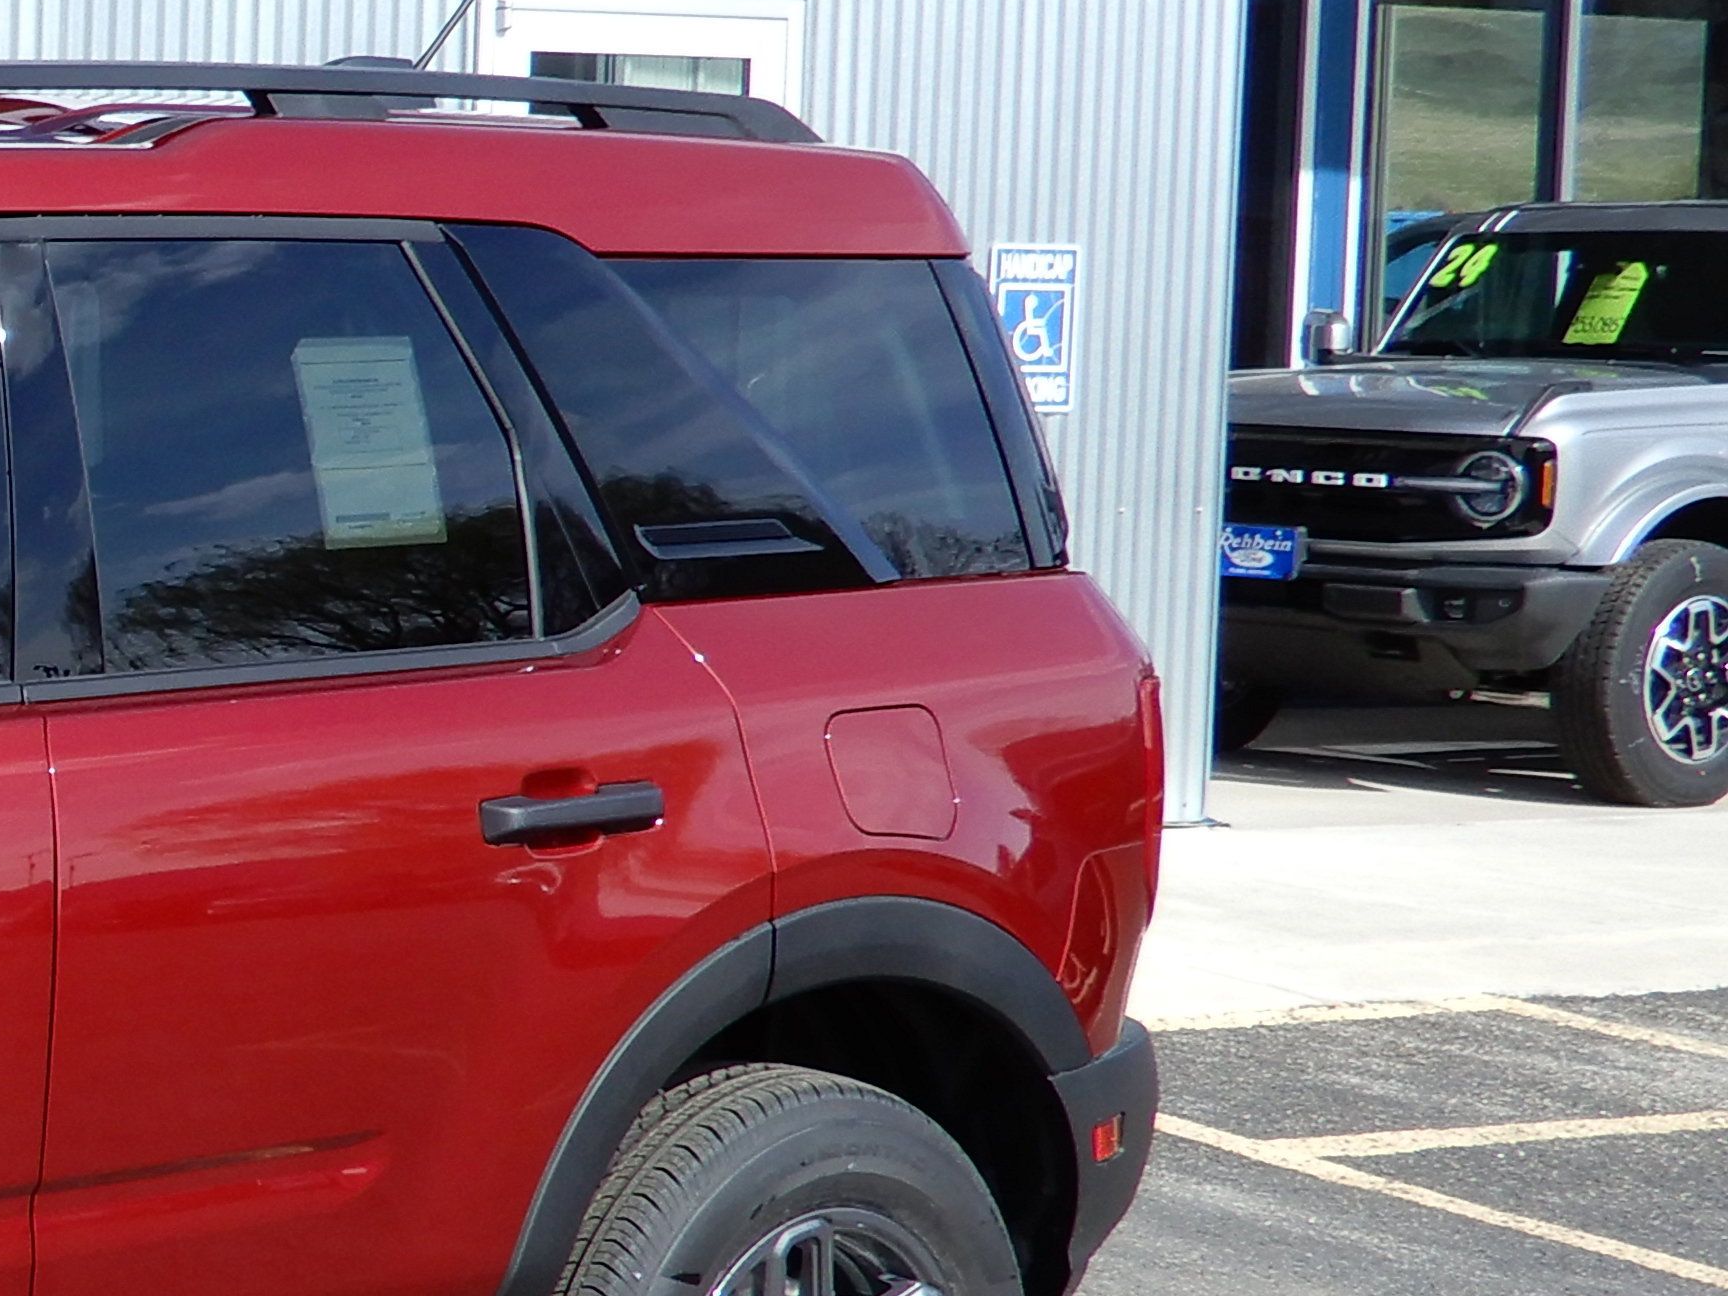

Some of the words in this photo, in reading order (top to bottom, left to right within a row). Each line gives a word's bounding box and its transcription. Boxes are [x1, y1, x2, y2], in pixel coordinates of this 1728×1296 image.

[1001, 253, 1074, 280] HANDICAP
[1428, 243, 1499, 288] 24
[1025, 375, 1067, 403] KING
[1219, 533, 1293, 553] Rehbein
